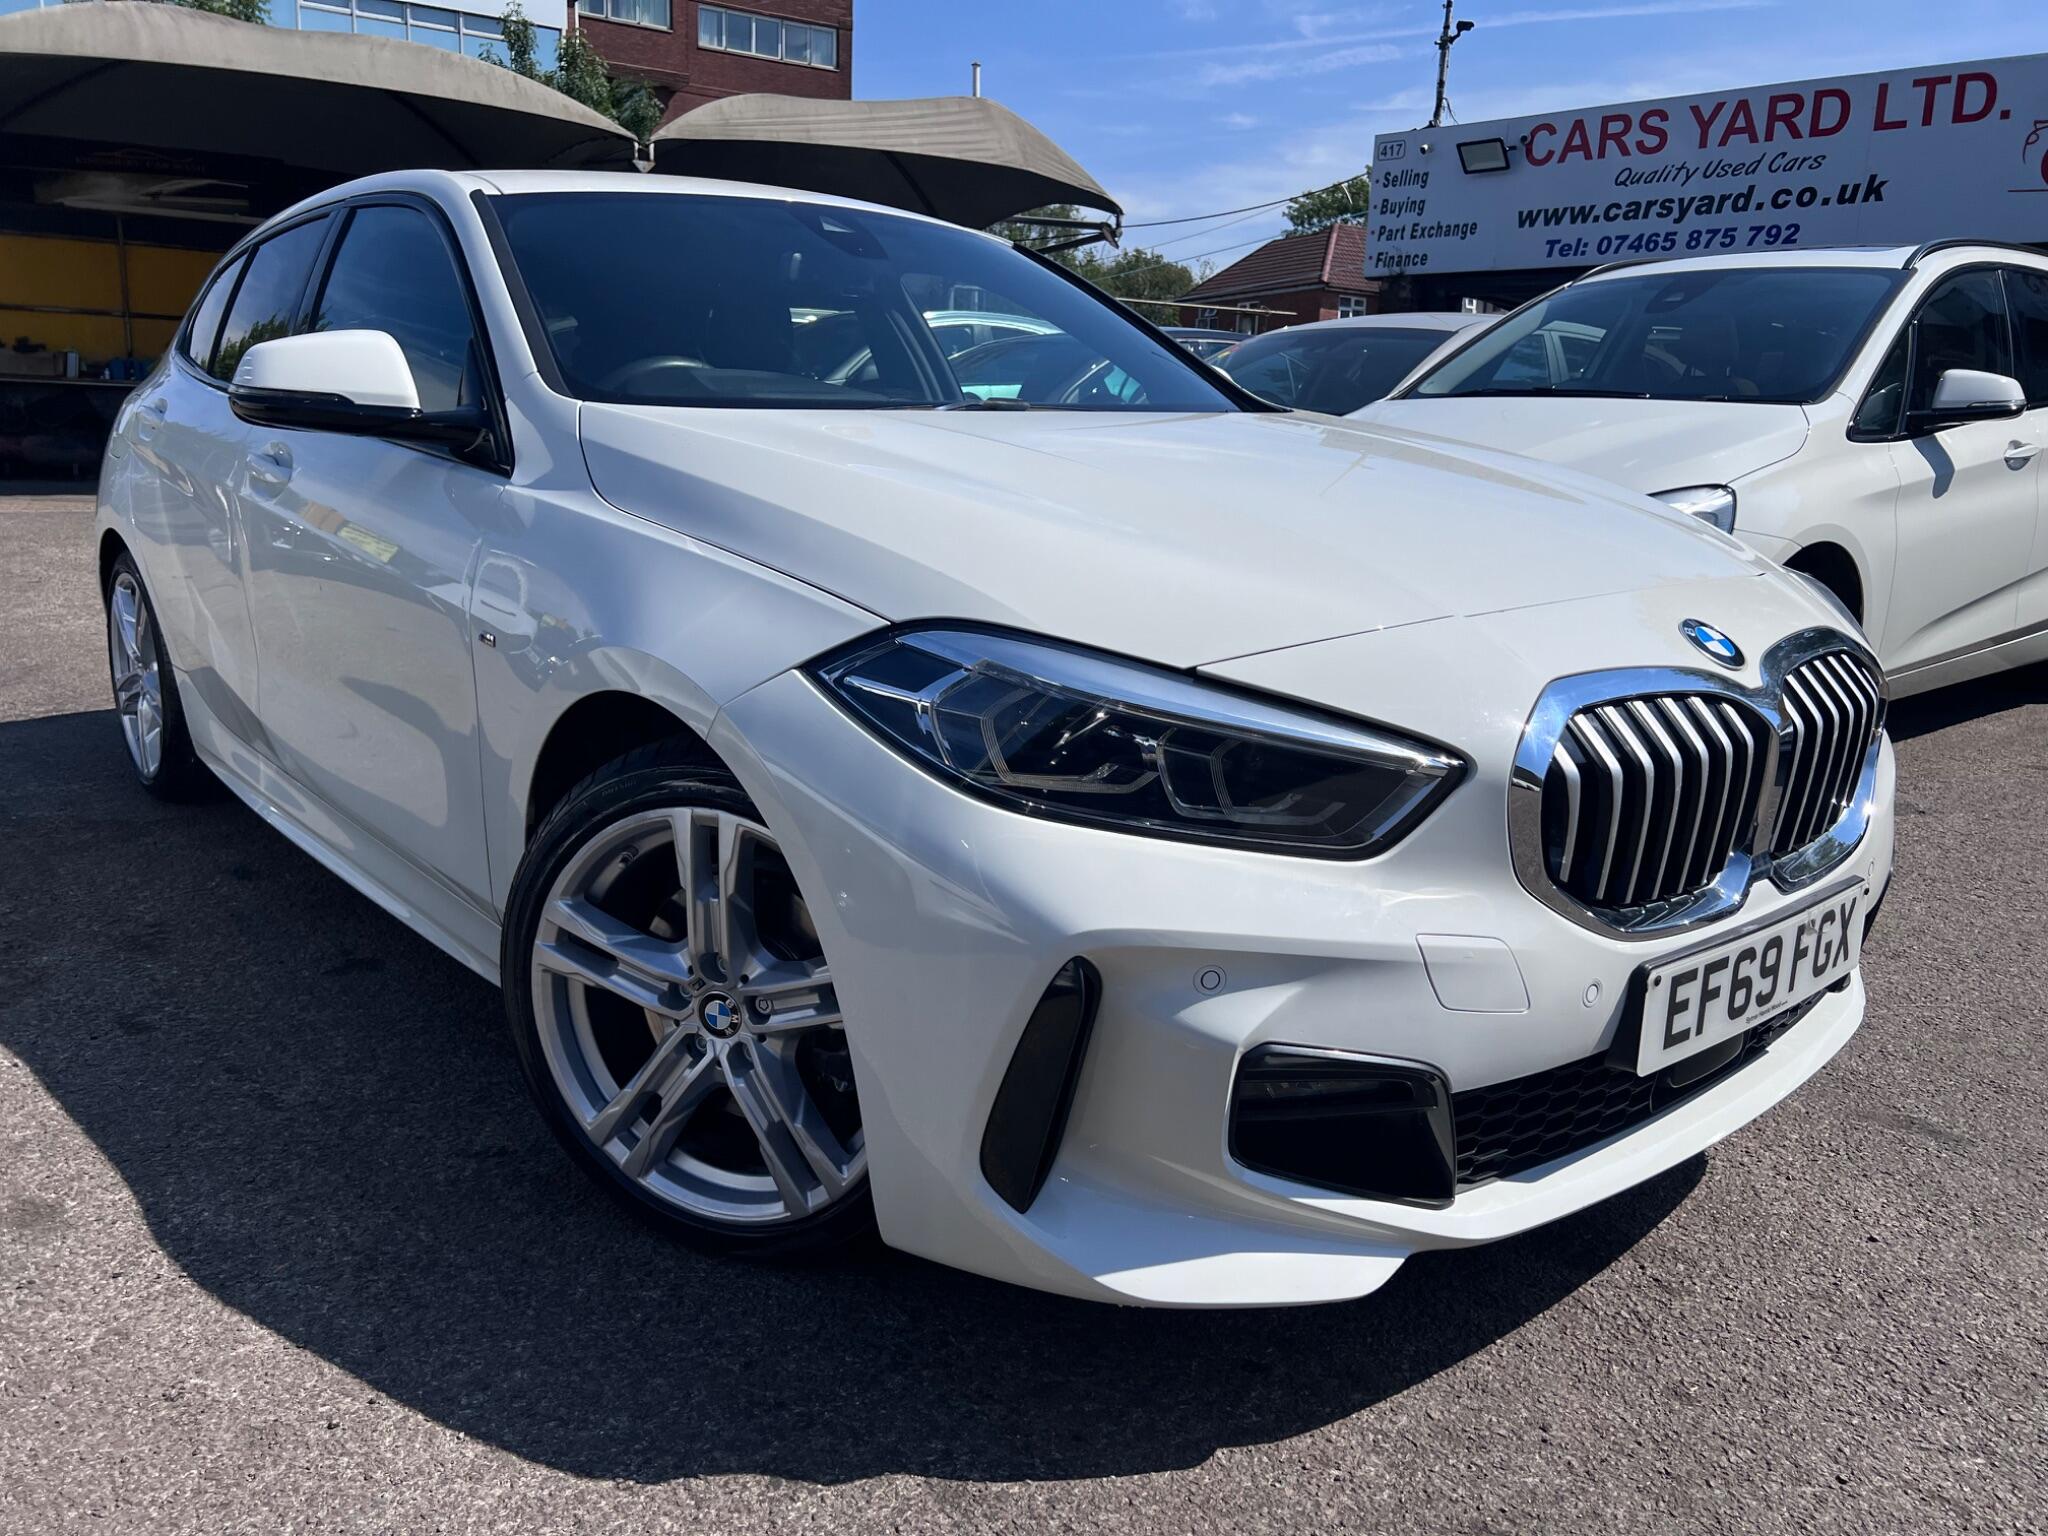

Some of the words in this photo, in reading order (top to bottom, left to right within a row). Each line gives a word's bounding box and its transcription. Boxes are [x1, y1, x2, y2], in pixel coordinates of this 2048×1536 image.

[1525, 109, 1669, 167] CARS
[1689, 88, 1851, 149] YARD
[1873, 72, 2011, 131] LTD.
[1380, 143, 1403, 158] 417
[1383, 169, 1429, 189] Selling
[1615, 161, 1700, 187] Quality
[1703, 152, 1767, 179] Used
[1768, 152, 1827, 173] Cars
[1380, 196, 1426, 217] Buying
[1518, 174, 1889, 228] www.carsyard.co.uk
[1377, 224, 1405, 242] Part
[1410, 221, 1477, 241] Exchange
[1545, 237, 1588, 258] Tel:
[1596, 231, 1677, 255] 07465
[1686, 227, 1737, 250] 875
[1746, 223, 1800, 247] 792
[1375, 251, 1428, 269] Finance
[1663, 935, 1783, 1050] EF69
[1788, 897, 1857, 993] FGX
